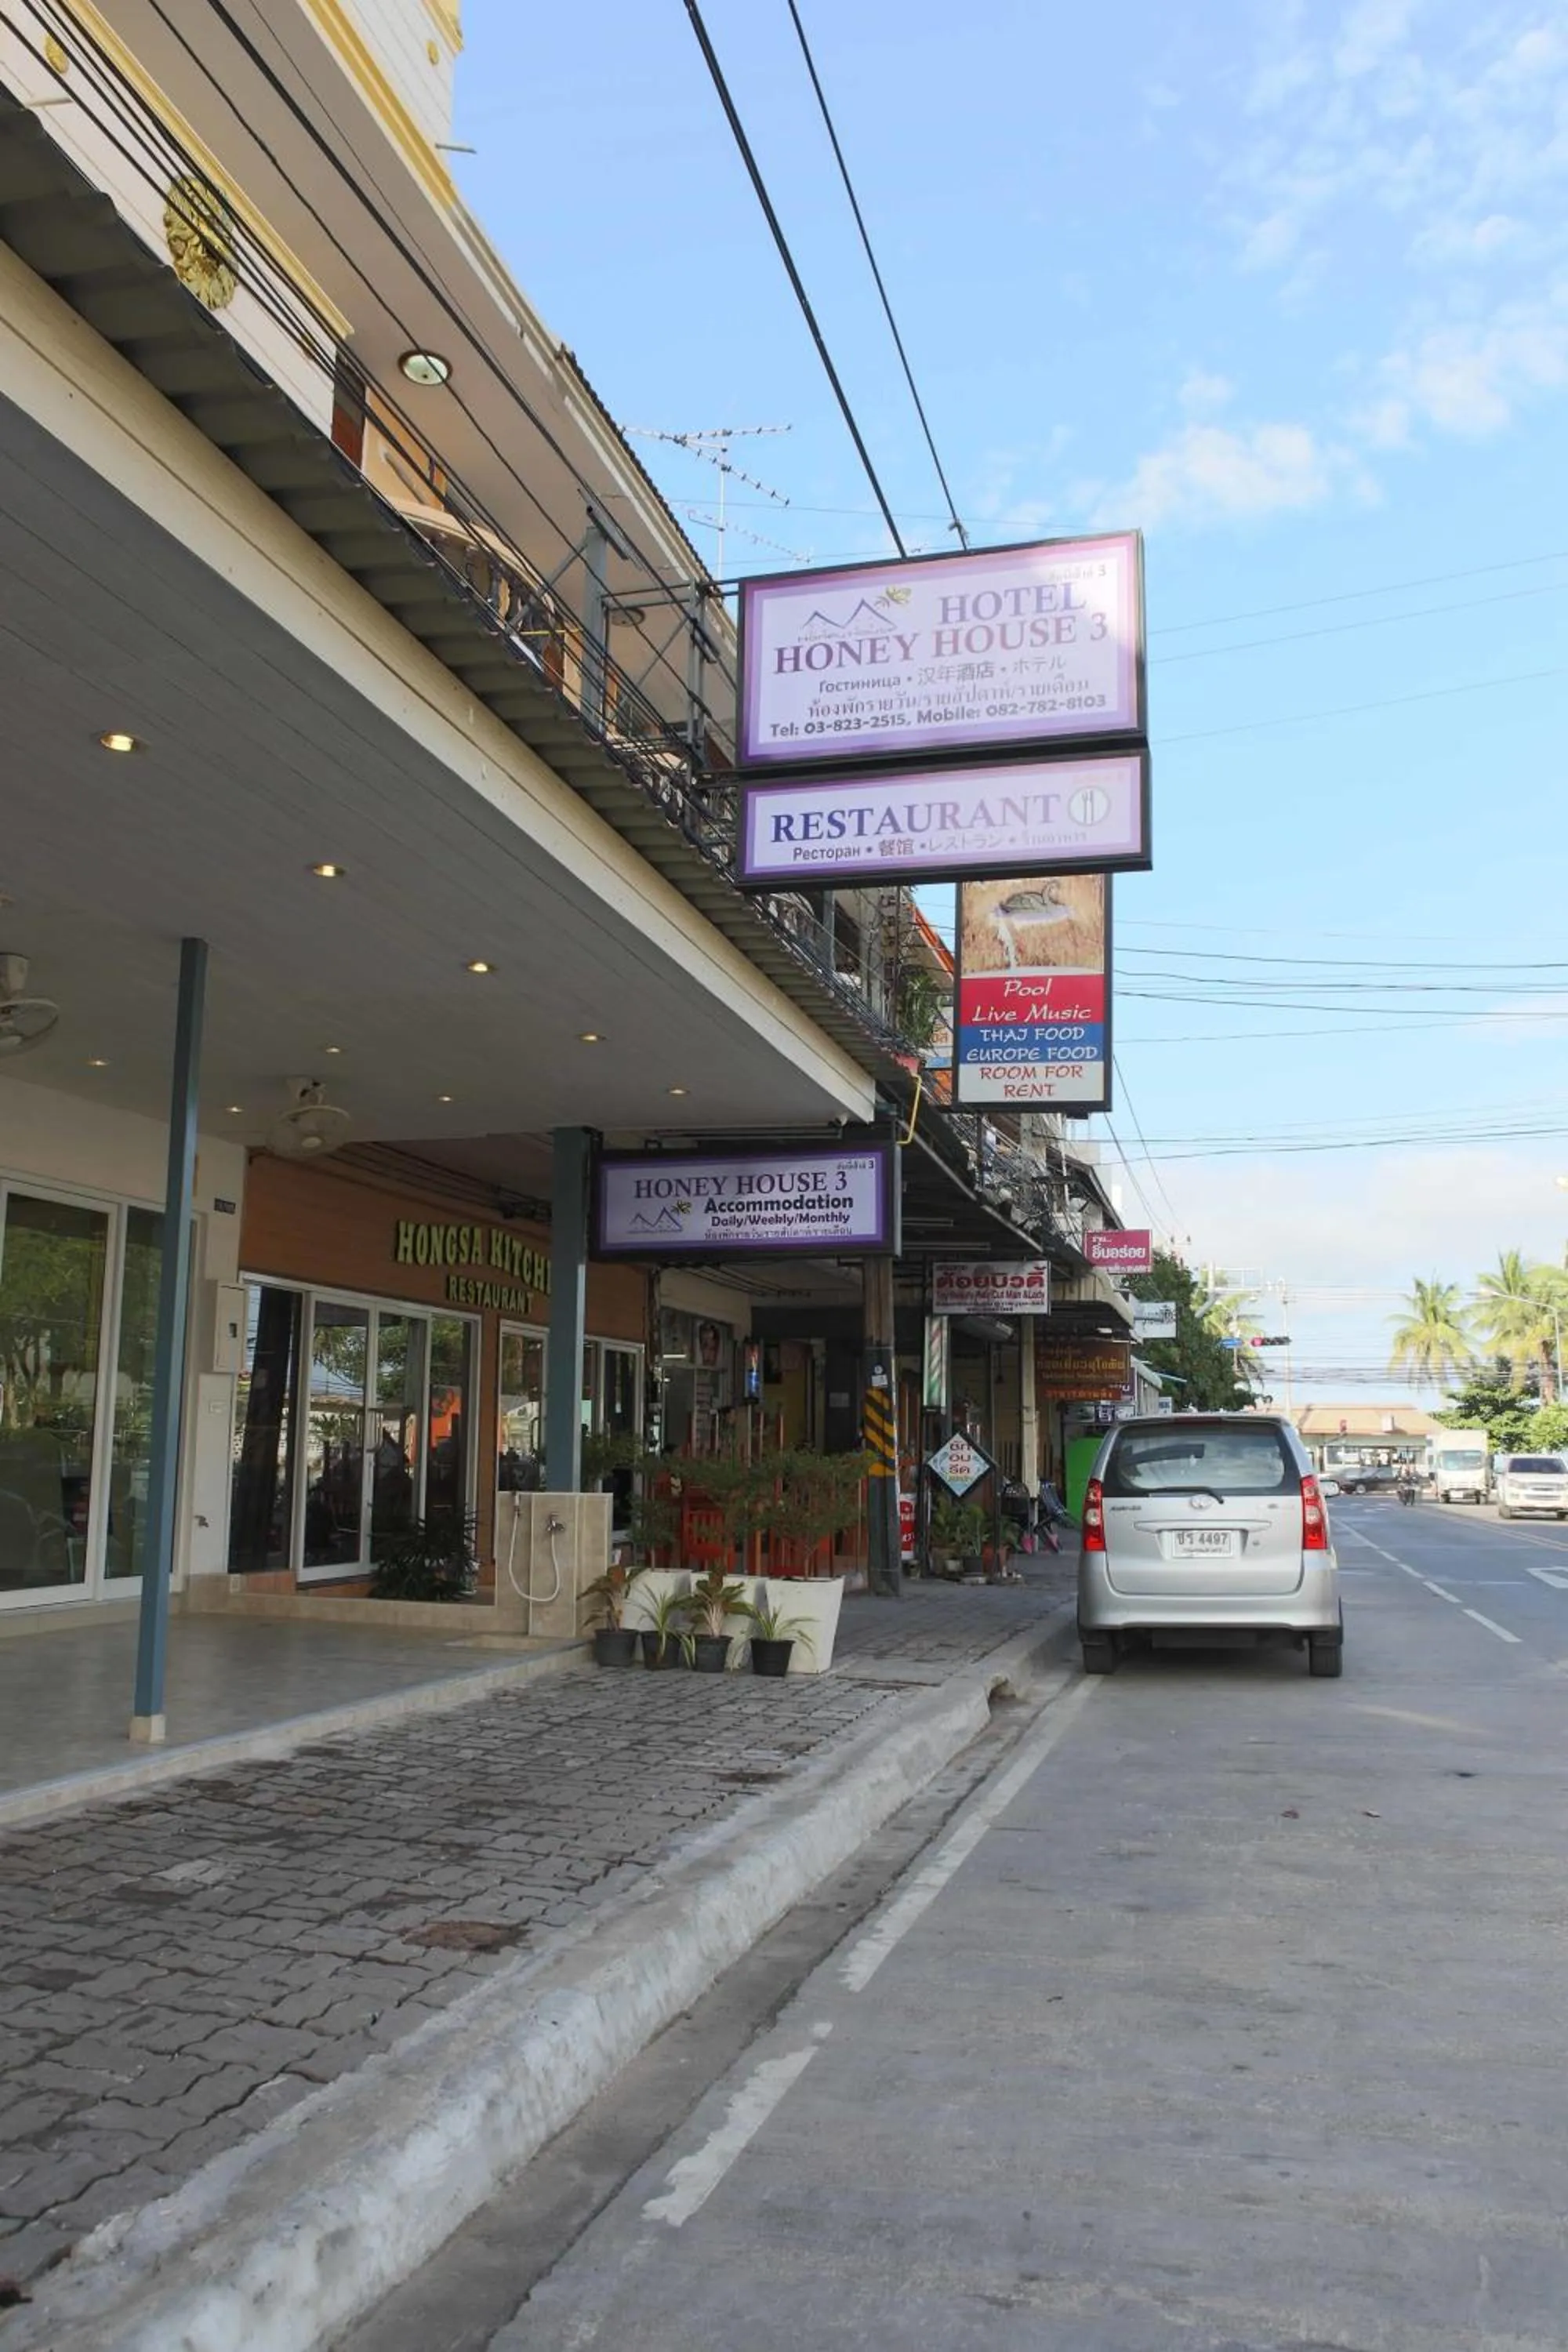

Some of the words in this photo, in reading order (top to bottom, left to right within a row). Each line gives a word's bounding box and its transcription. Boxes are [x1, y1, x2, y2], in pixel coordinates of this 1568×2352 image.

[939, 583, 1086, 624] HOTEL
[774, 633, 920, 674] HONEY
[932, 616, 1078, 659] HOUSE
[1090, 612, 1109, 641] 3
[819, 676, 901, 694] Гостиница
[1013, 655, 1066, 674] ホテル
[771, 722, 799, 737] Tel:
[804, 714, 912, 734] 03-823-2515,
[917, 706, 980, 724] Mobile:
[986, 695, 1106, 717] 082-782-8103
[771, 794, 1061, 843] RESTAURANT
[793, 847, 861, 862] Ресторан
[929, 833, 1003, 851] レストラン
[1004, 978, 1051, 998] Pool
[972, 1007, 1017, 1022] Live
[1024, 1004, 1092, 1023] Music
[1035, 1027, 1084, 1040] FOOD
[967, 1047, 1040, 1061] EUROPE
[1048, 1046, 1098, 1059] FOOD
[981, 1066, 1039, 1080] ROOM
[1045, 1065, 1083, 1079] FOR
[1004, 1083, 1055, 1098] RENT
[634, 1176, 727, 1200] HONEY
[737, 1171, 827, 1194] HOUSE
[835, 1171, 848, 1191] 3
[704, 1194, 854, 1214] Accommodation
[711, 1211, 851, 1228] Daily/Weekly/Monthly
[397, 1220, 482, 1266] HONGSA
[448, 1274, 534, 1314] RESTAURANT
[1199, 1533, 1228, 1544] 4497
